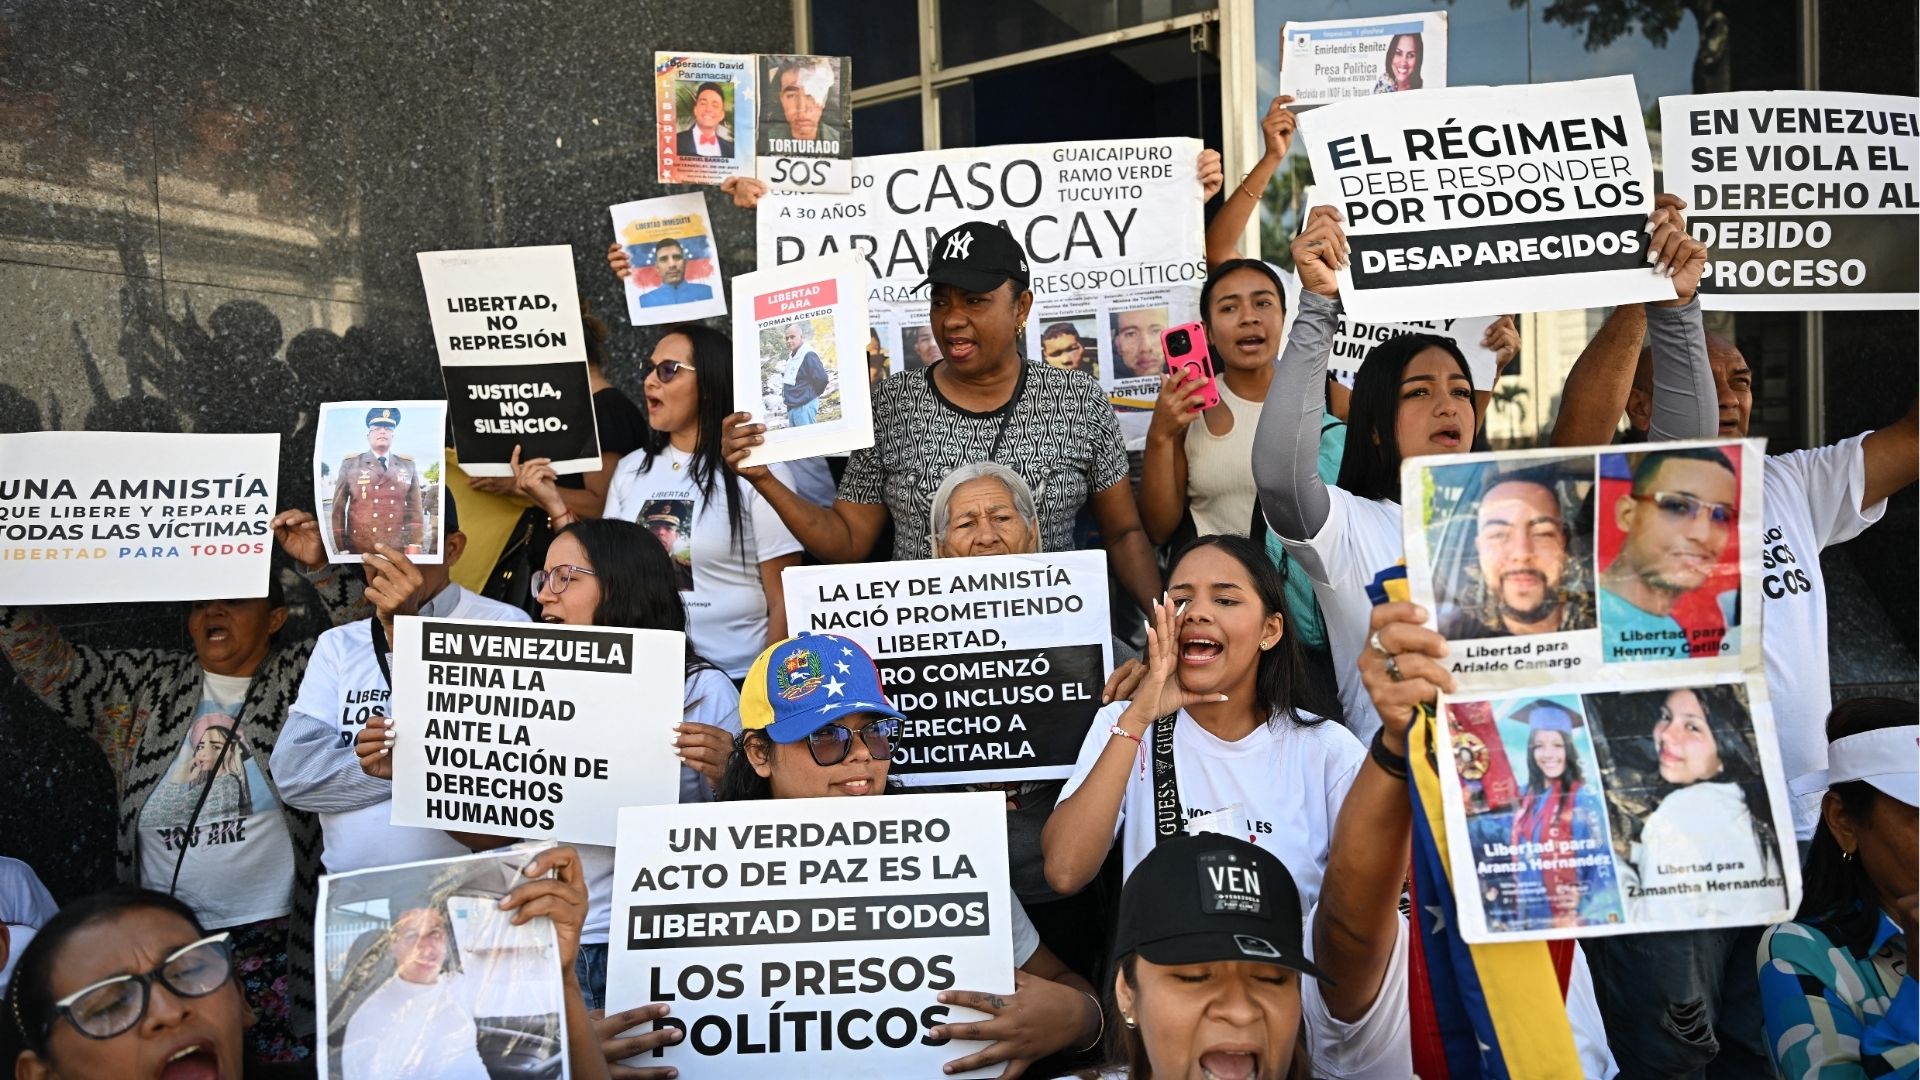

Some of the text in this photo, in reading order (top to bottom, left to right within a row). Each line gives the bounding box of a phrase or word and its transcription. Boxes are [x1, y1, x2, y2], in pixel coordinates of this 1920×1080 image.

[678, 70, 732, 83] Paramacay
[719, 62, 744, 70] David
[1315, 63, 1340, 76] Presa
[662, 80, 674, 166] LIBERTAD
[1690, 108, 1919, 137] EN VENEZUEL
[768, 138, 840, 154] TORTURADO
[1053, 146, 1173, 162] GUAICAIPURO
[1327, 115, 1628, 171] EL RÉGIMEN
[1691, 145, 1908, 172] SE VIOLA EL
[771, 158, 831, 186] SOS
[1059, 164, 1173, 183] RAMO VERDE
[1340, 155, 1632, 198] DEBE RESPONDER
[886, 159, 1042, 214] CASO
[1058, 186, 1142, 202] TUCUYITO
[1694, 182, 1919, 210] DERECHO AL
[780, 203, 866, 219] A 30 AÑOS
[1346, 180, 1644, 228] POR TODOS LOS
[635, 221, 661, 231] LIBERTAD
[1692, 220, 1832, 249] DEBIDO
[1361, 229, 1640, 274] DESAPARECIDOS
[1033, 261, 1207, 296] RESOS POLÍTICOS
[447, 295, 557, 312] LIBERTAD,
[768, 285, 820, 304] LIBERTAD
[781, 299, 811, 311] PARA
[487, 316, 517, 330] NO
[758, 308, 833, 328] YORMAN ACEVEDO
[1335, 320, 1347, 336] A
[449, 329, 566, 350] REPRESIÓN
[467, 383, 561, 400] JUSTICIA,
[500, 402, 529, 417] NO
[474, 417, 568, 434] SILENCIO.
[0, 473, 268, 500] UNA AMNISTÍA
[0, 504, 268, 521] QUE LIBERE Y REPARE A
[91, 523, 140, 540] LAS
[148, 519, 268, 539] VÍCTIMAS
[3, 543, 265, 560] IBERTAD PARA TODOS
[819, 565, 1071, 602] LA LEY DE AMNISTÍA
[810, 594, 1083, 630] NACIÓ PROMETIENDO
[877, 628, 1007, 654] LIBERTAD,
[1620, 626, 1725, 642] Libertad para
[429, 632, 626, 666] EN VENEZUELA
[1467, 641, 1568, 658] Libertad para
[923, 653, 1050, 683] COMENZÓ
[1514, 655, 1581, 671] Camargo
[428, 664, 545, 691] REINA LA
[346, 689, 391, 704] LIBER
[426, 691, 575, 721] IMPUNIDAD
[945, 684, 1054, 708] INCLUSO
[1062, 682, 1091, 701] EL
[425, 718, 531, 746] ANTE LA
[1008, 714, 1027, 732] A
[1156, 715, 1175, 754] GUES
[425, 745, 608, 779] VIOLACIÓN DE
[891, 740, 1036, 765] OLICITARLA
[426, 772, 563, 803] DERECHOS
[426, 798, 554, 830] HUMANOS
[156, 826, 200, 851] YOU
[668, 818, 951, 853] UN VERDADERO
[1483, 838, 1596, 857] Libertad para
[631, 854, 978, 892] ACTO DE PAZ ES LA
[1478, 853, 1611, 874] Aranza Hernandez
[1657, 861, 1744, 875] Libertad para
[1208, 866, 1261, 895] VEN
[1628, 877, 1785, 898] Zamantha Hernandez
[633, 901, 985, 940] LIBERTAD DE TODOS
[650, 954, 956, 1003] LOS PRESOS
[652, 1001, 951, 1058] POLÍTICOS
